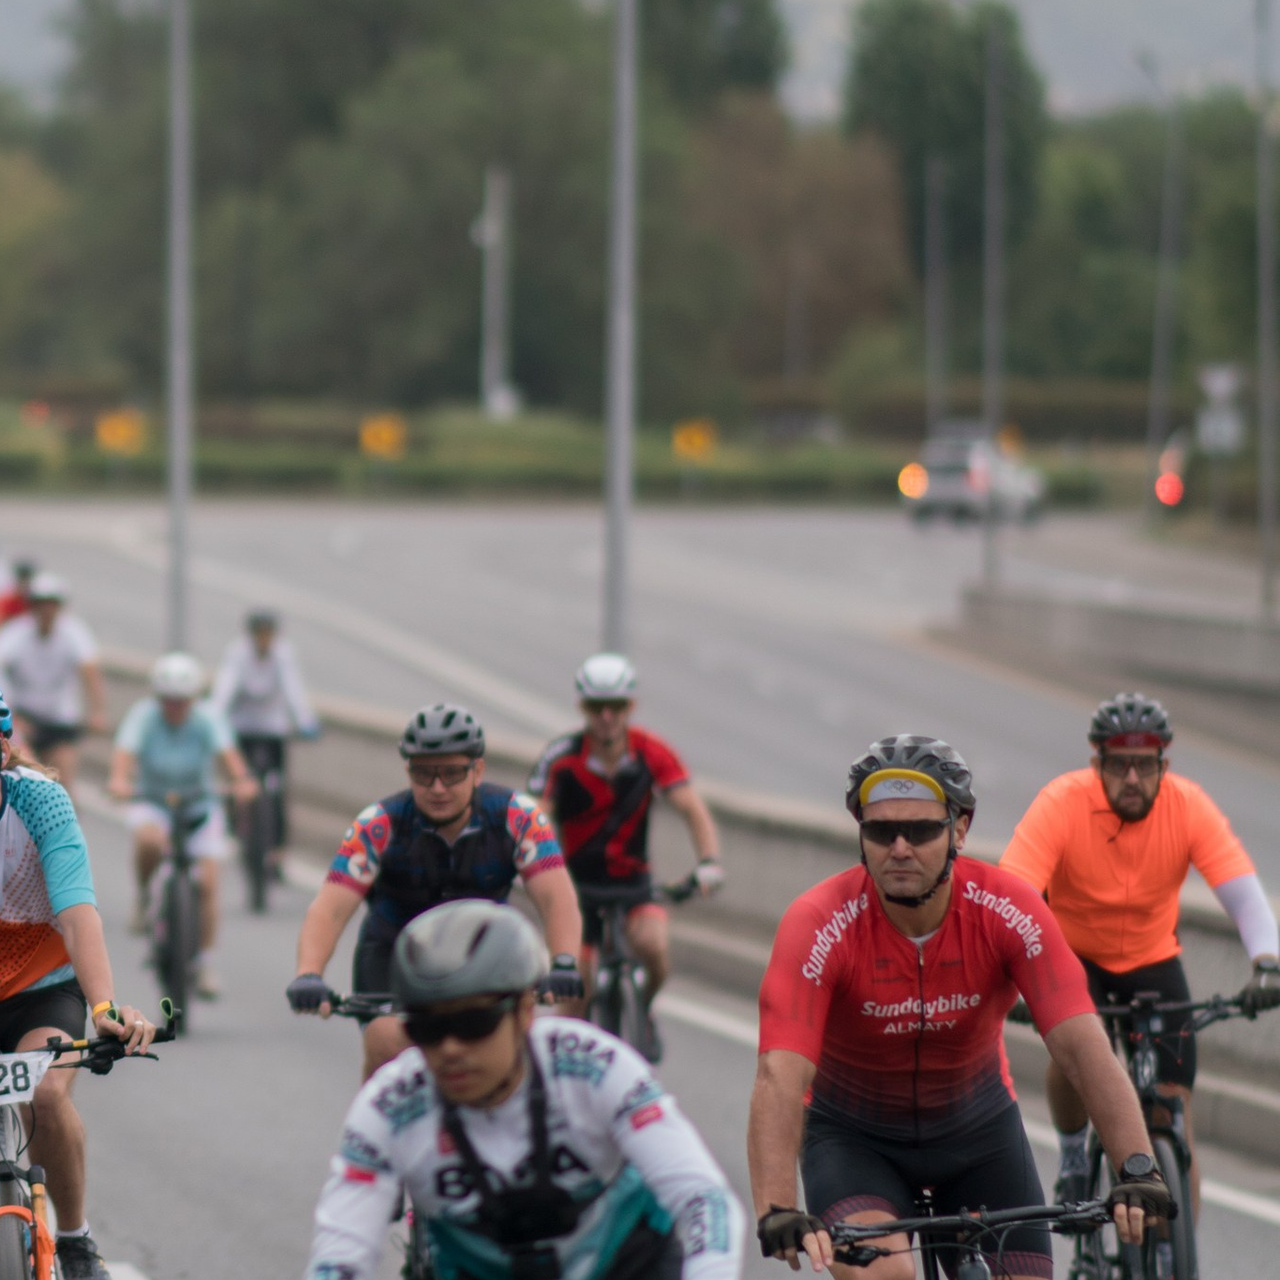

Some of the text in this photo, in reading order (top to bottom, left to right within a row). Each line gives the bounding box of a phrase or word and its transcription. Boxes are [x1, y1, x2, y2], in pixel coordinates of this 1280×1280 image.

[962, 881, 1043, 960] Sundaybike
[861, 993, 981, 1019] Sundaybike
[883, 1019, 957, 1035] ALMATY
